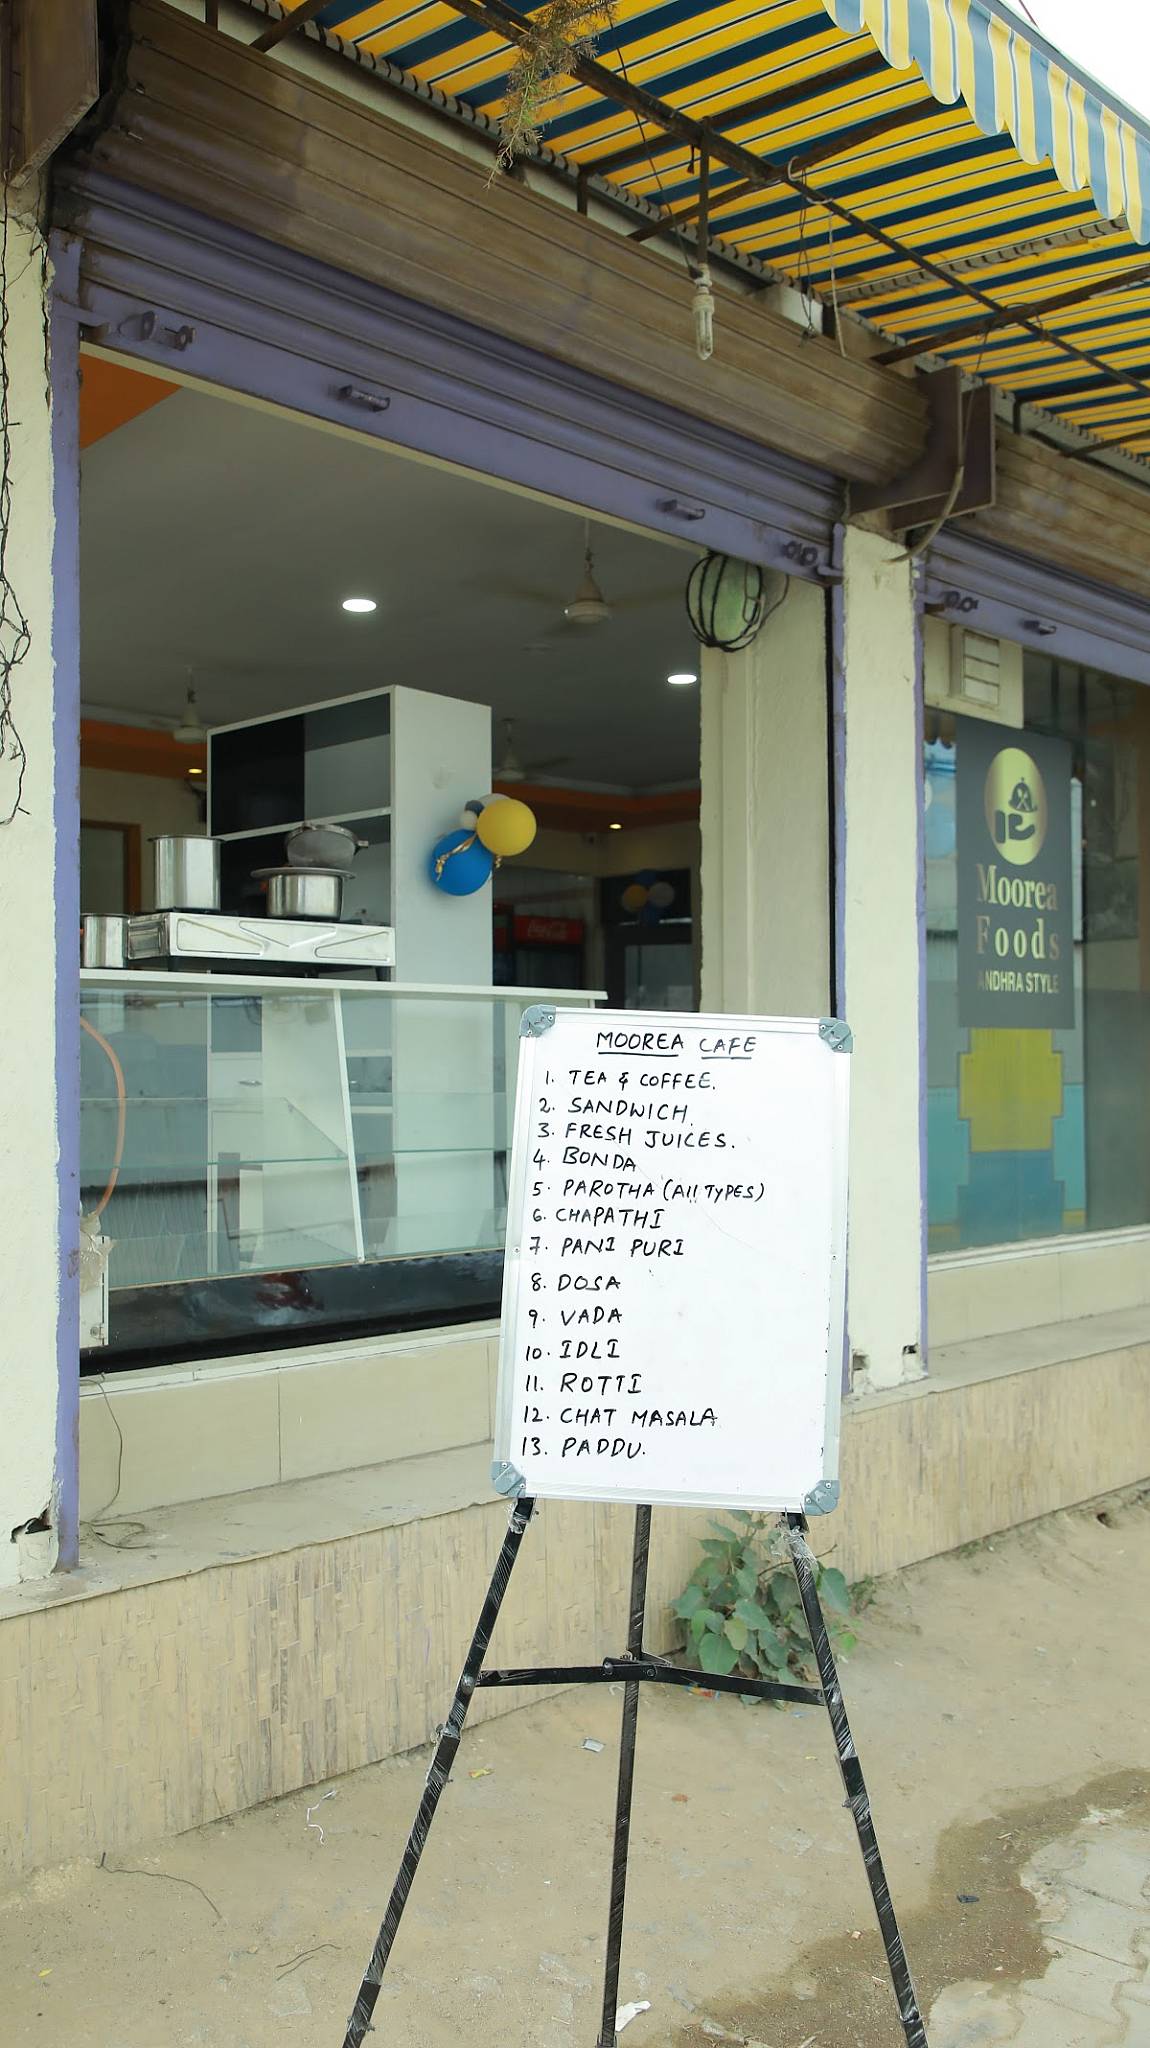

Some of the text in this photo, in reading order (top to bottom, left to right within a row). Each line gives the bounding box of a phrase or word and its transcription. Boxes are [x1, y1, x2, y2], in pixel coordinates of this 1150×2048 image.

[976, 864, 1058, 910] Moorea
[976, 915, 1061, 960] Foods
[1025, 971, 1060, 994] STYLE
[596, 1031, 757, 1055] MOOREA CAFE
[545, 1070, 555, 1085] 1.
[568, 1069, 607, 1086] TEA
[538, 1097, 555, 1114] 2.
[537, 1122, 735, 1149] 3. FRESH JUICES.
[532, 1145, 637, 1173] 4. BONDA
[532, 1181, 551, 1197] 5.
[563, 1178, 655, 1200] PAROTHA
[532, 1206, 665, 1230] 6. CHAPATHI
[529, 1235, 684, 1258] 7. PANI PURI
[530, 1272, 621, 1292] 8. DOSA
[528, 1305, 623, 1329] 9. VADA
[525, 1338, 621, 1362] 10. IDLI
[525, 1372, 642, 1396] 11. ROTTI
[523, 1405, 718, 1428] 12. CHAT MASALA
[521, 1436, 646, 1460] 13. PADDU.
